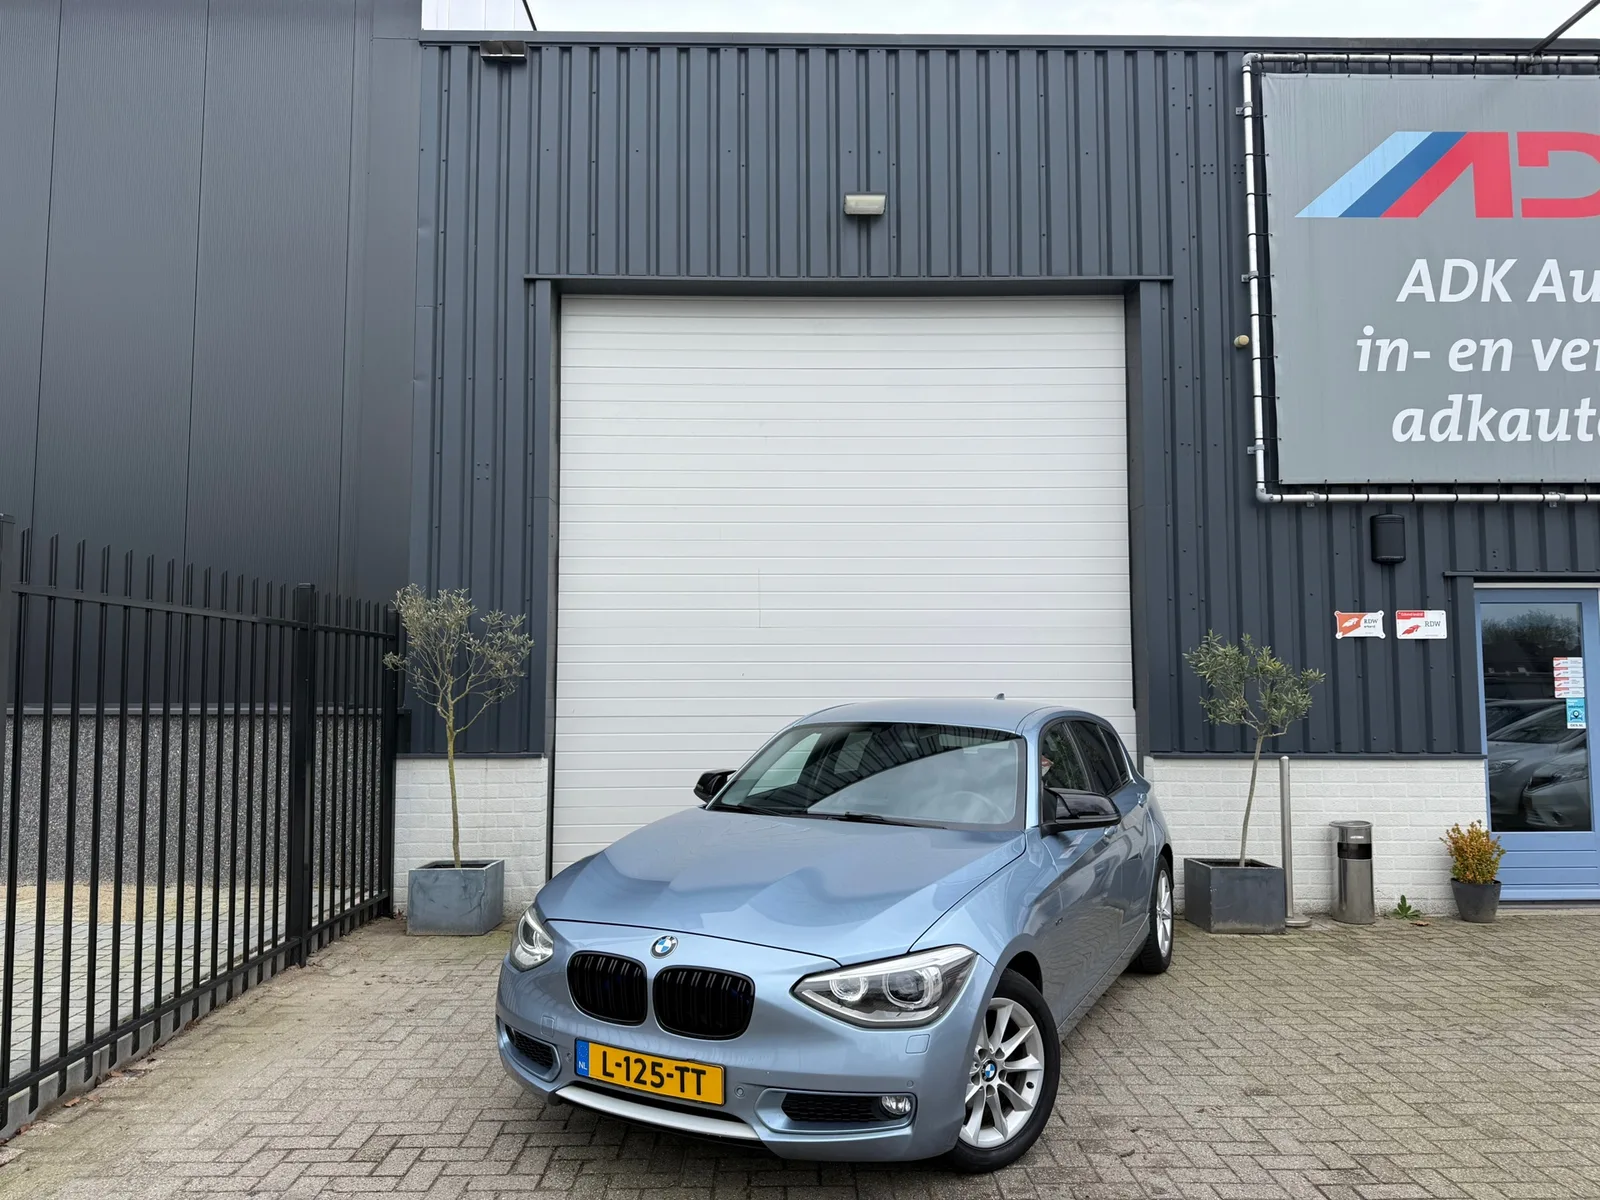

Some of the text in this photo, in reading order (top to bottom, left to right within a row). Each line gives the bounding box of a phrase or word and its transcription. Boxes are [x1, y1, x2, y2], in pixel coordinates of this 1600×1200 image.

[1396, 258, 1600, 304] ADK Au
[1356, 325, 1431, 372] in-
[1448, 337, 1513, 372] en
[1391, 394, 1600, 442] adkaut
[578, 1060, 588, 1071] NL
[602, 1050, 706, 1096] L-125-TT
